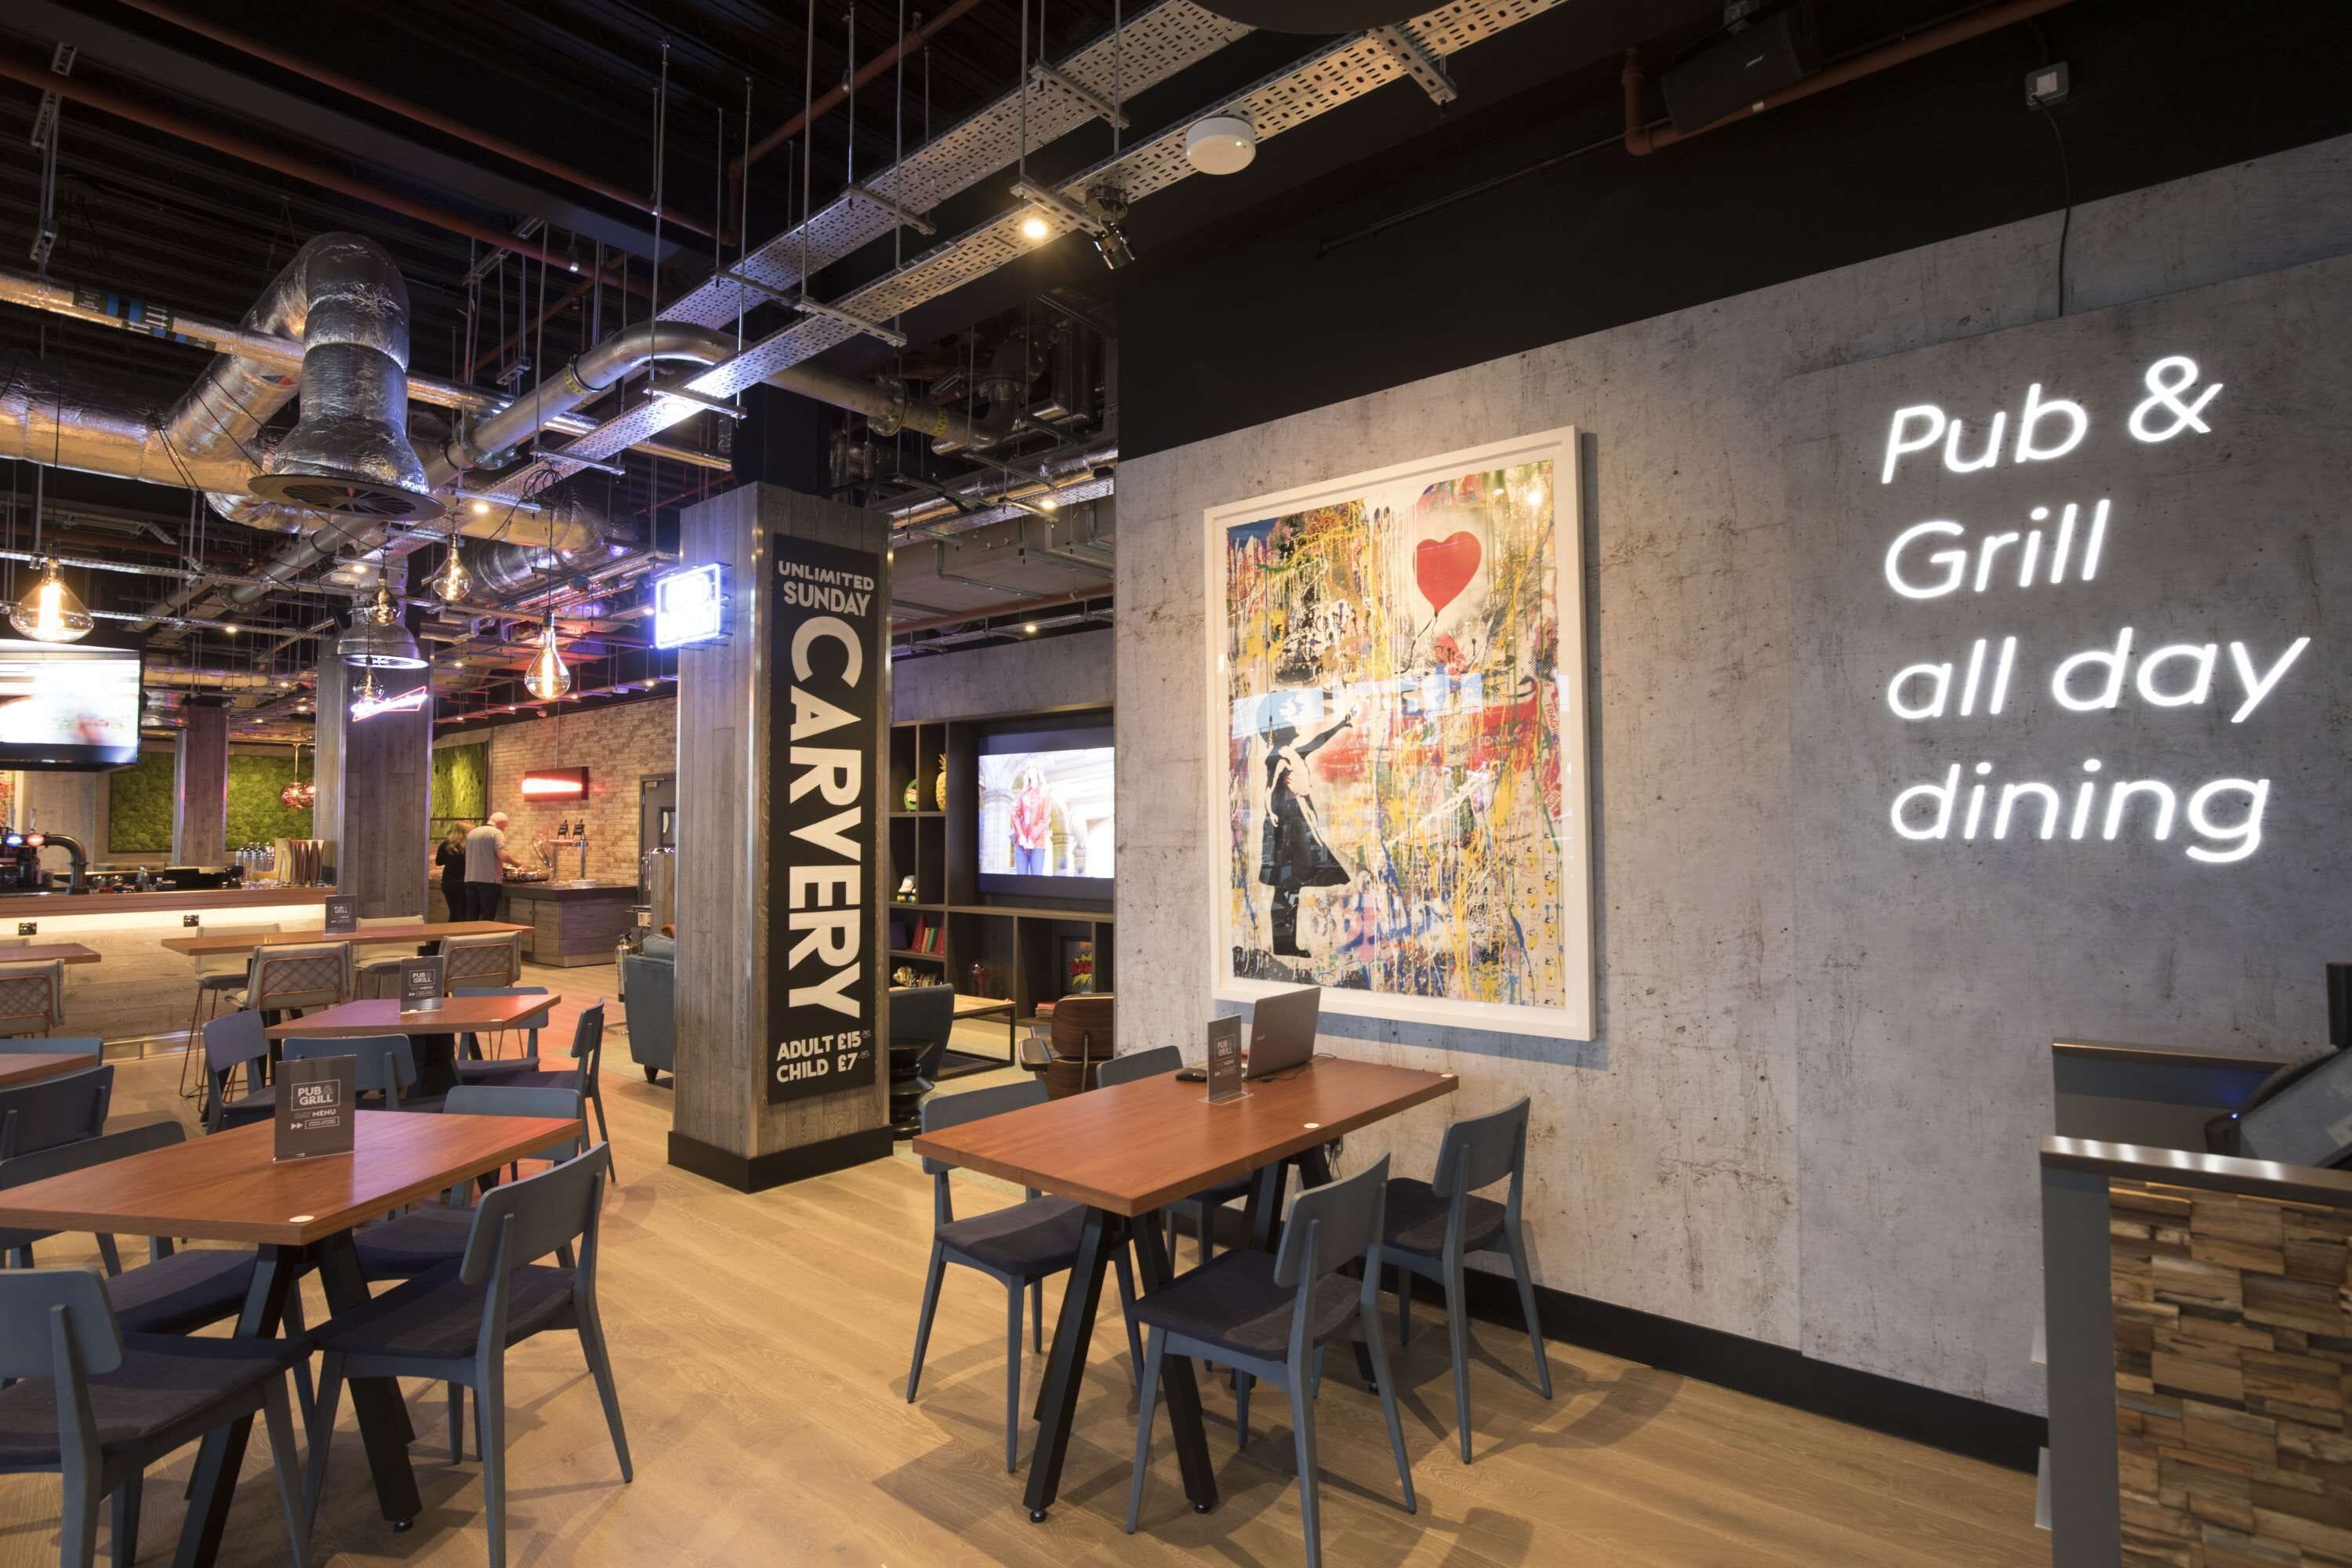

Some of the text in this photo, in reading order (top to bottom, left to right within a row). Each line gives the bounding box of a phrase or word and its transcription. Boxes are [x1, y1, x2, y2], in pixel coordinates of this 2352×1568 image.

[1881, 355, 2224, 485] Pub &
[1884, 499, 2111, 599] Grill
[778, 561, 875, 592] UNLIMITED
[783, 581, 872, 617] SUNDAY
[1887, 626, 2311, 724] all day
[788, 615, 863, 1019] CARVERY
[1890, 758, 2271, 863] dining
[776, 1034, 834, 1062] ADULT
[1217, 1040, 1228, 1049] PUB
[1218, 1047, 1233, 1057] GRILL
[776, 1058, 829, 1083] CHILD
[297, 1086, 322, 1098] PUB
[299, 1094, 333, 1105] GRILL
[312, 1109, 337, 1118] MENU
